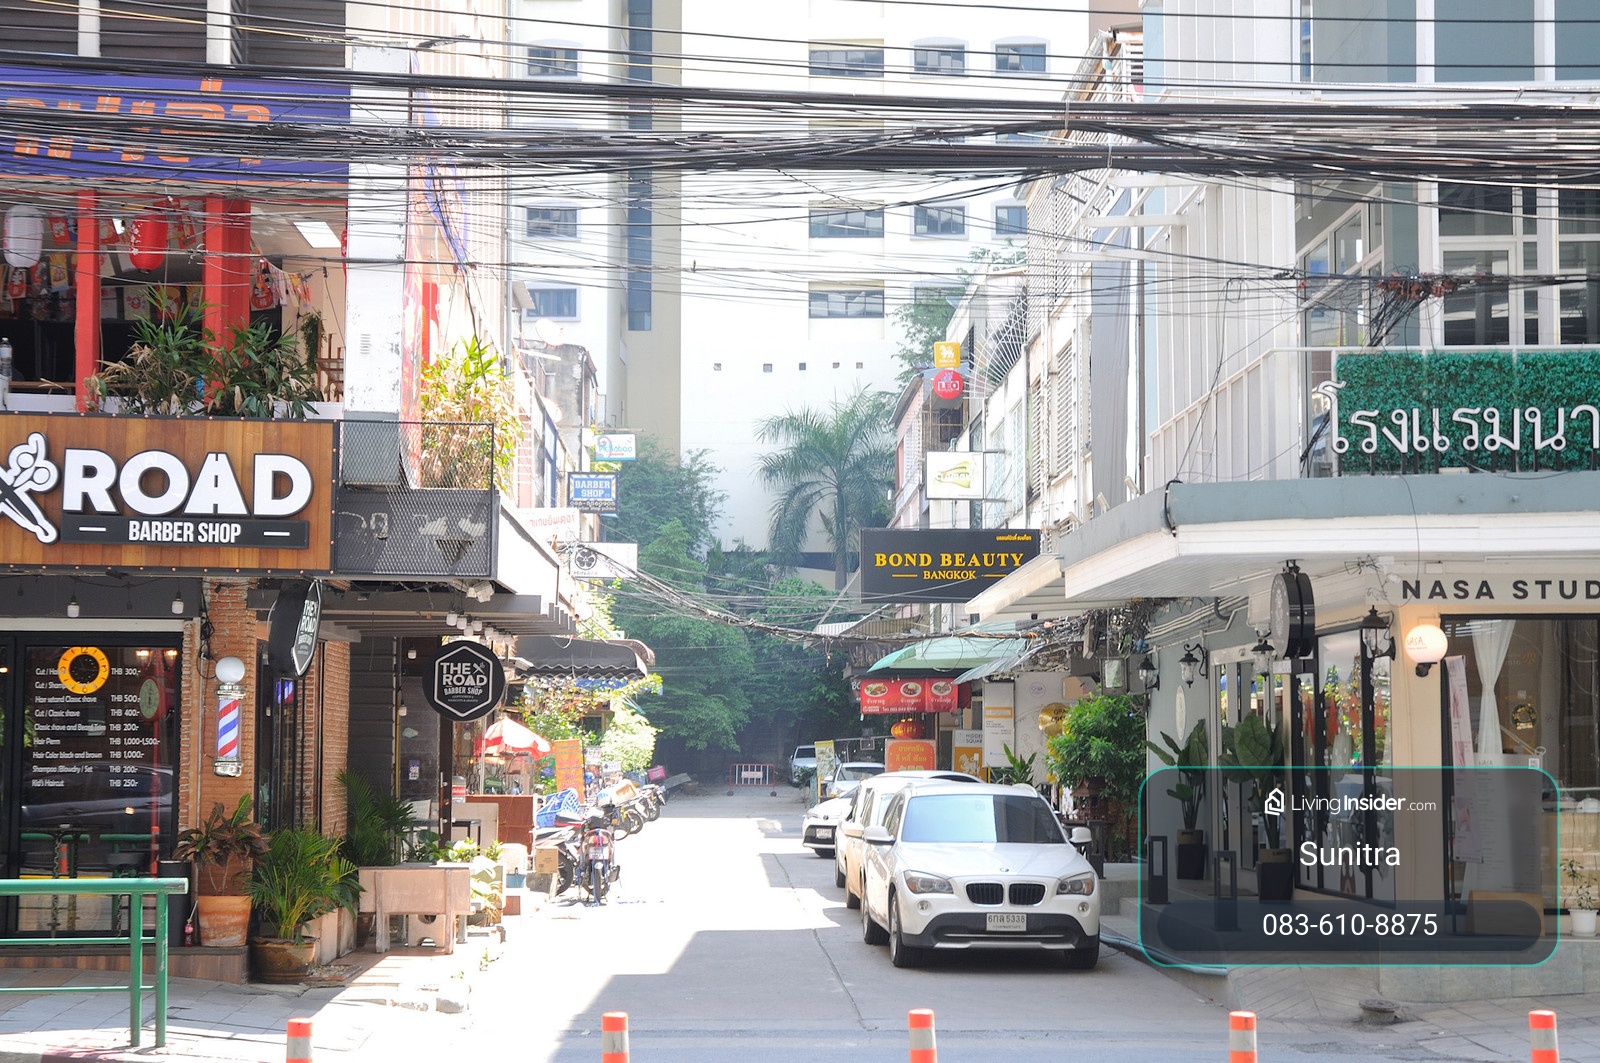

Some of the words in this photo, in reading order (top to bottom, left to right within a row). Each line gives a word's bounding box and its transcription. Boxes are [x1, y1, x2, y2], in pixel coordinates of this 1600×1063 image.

[938, 381, 960, 390] LEO
[62, 447, 313, 516] ROAD
[574, 480, 611, 489] BARBER
[581, 489, 605, 498] SHOP
[128, 520, 194, 542] BARBER
[198, 523, 242, 543] SHOP
[874, 553, 933, 567] BOND
[940, 553, 1024, 567] BEAUTY
[923, 570, 977, 580] BANGKOK
[1402, 580, 1494, 599] NASA
[1512, 580, 1600, 600] STUD
[440, 662, 471, 675] THE
[442, 674, 488, 686] ROAD
[444, 686, 466, 696] BARBER
[467, 686, 483, 696] SHOP
